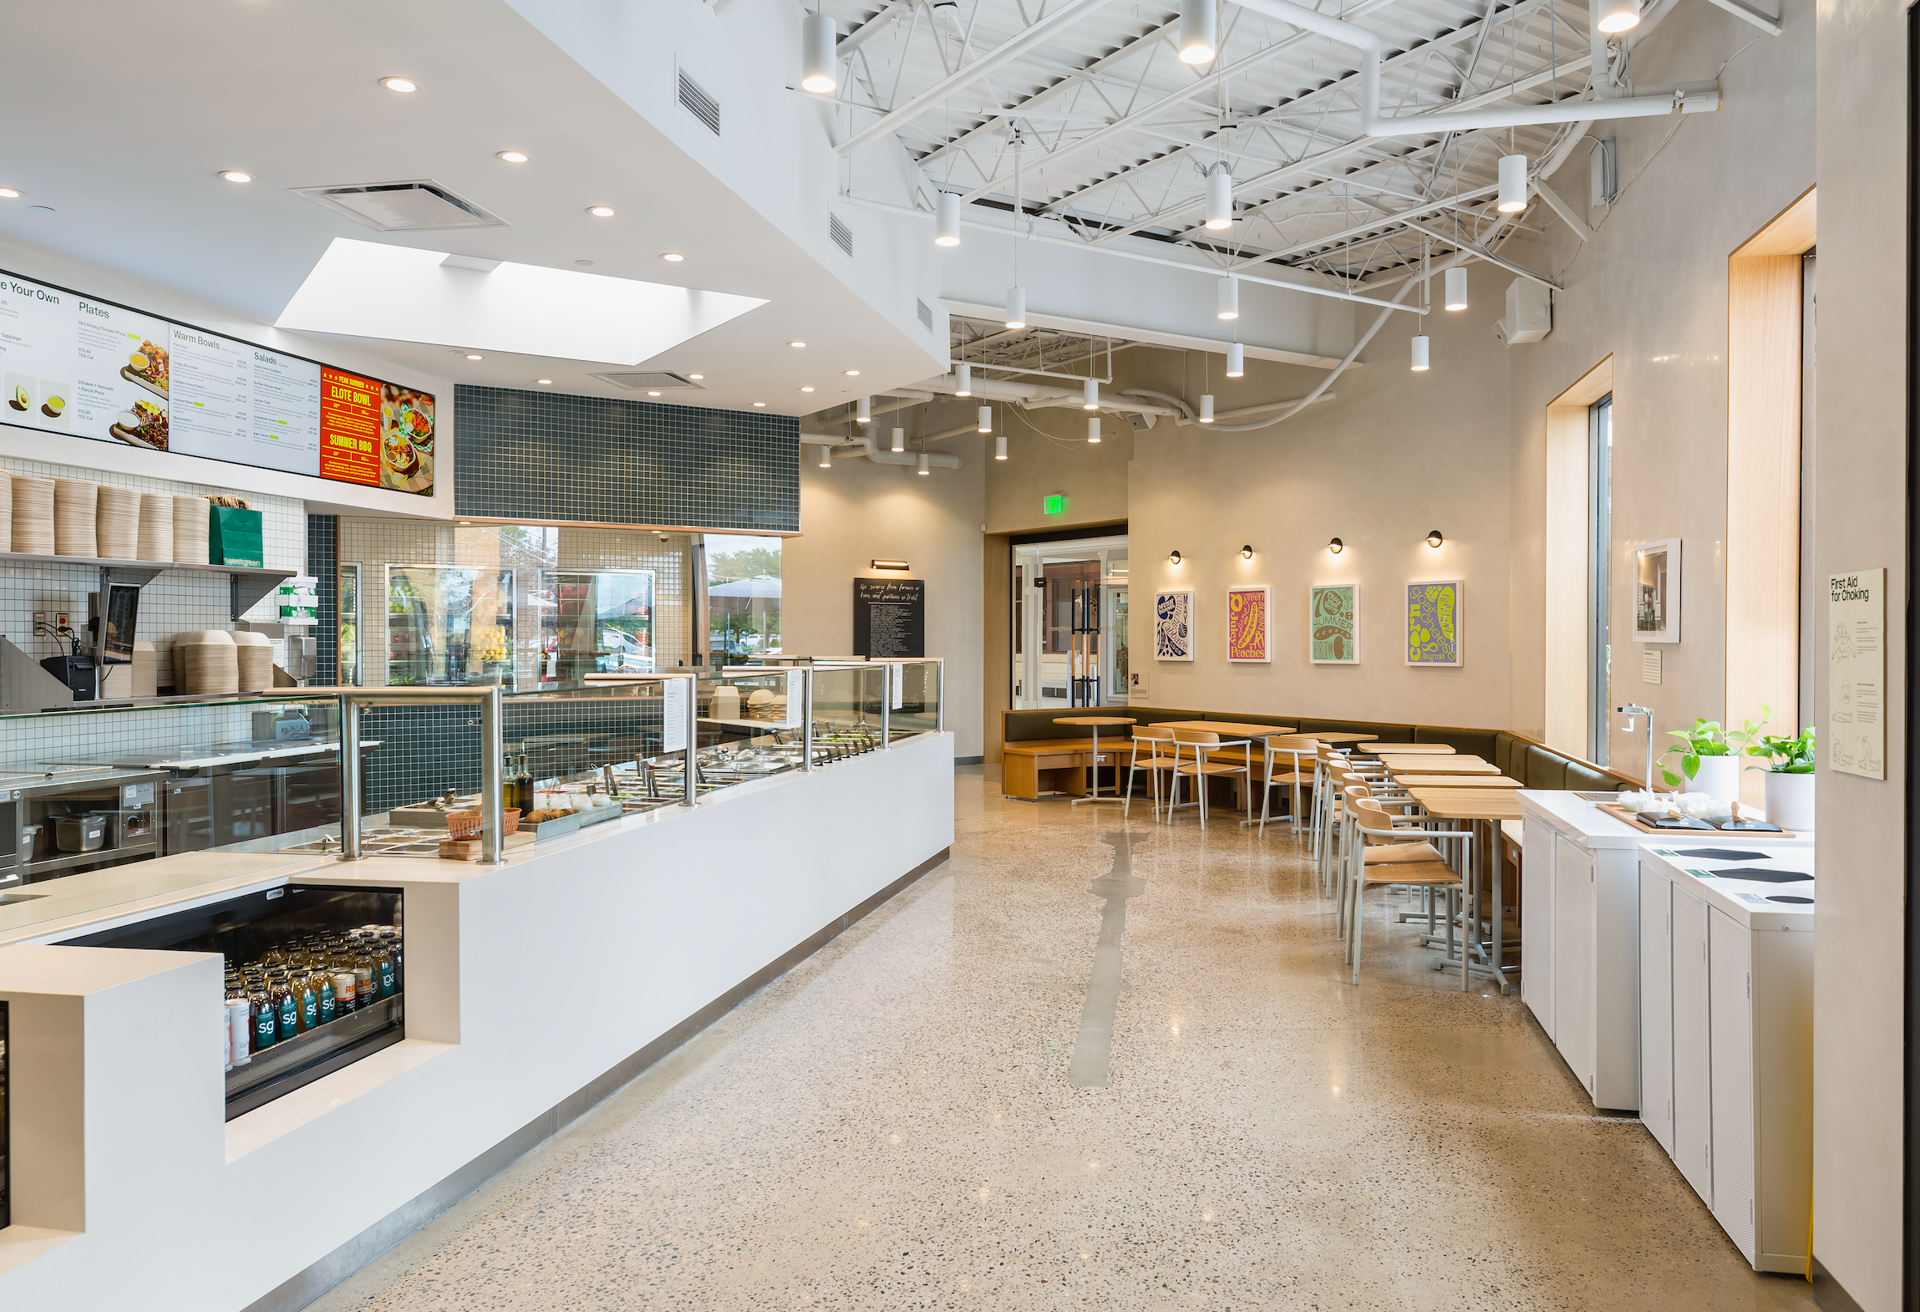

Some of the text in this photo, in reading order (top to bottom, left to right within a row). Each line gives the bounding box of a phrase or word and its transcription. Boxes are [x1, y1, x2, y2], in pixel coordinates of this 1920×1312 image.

[10, 281, 34, 297] Your
[36, 289, 60, 305] Own
[78, 301, 110, 319] Plates
[173, 329, 220, 350] Warm Bowls
[254, 351, 277, 365] Salads
[349, 378, 365, 389] SUMMER
[331, 385, 352, 402] ELOTE
[353, 391, 371, 407] BOWL
[330, 433, 372, 453] SUMMER BBQ
[223, 557, 261, 567] sweetgreen
[1831, 576, 1858, 590] First Aid
[1243, 592, 1264, 605] green
[1409, 586, 1436, 618] goat
[1831, 588, 1869, 602] for Choking
[1230, 611, 1238, 646] Juicy
[1313, 616, 1353, 632] SUMMER
[1420, 612, 1456, 662] cheese
[1230, 646, 1265, 658] Peaches
[1421, 652, 1445, 662] August
[322, 997, 336, 1011] sg
[282, 1011, 297, 1025] sg
[258, 1020, 275, 1035] sg
